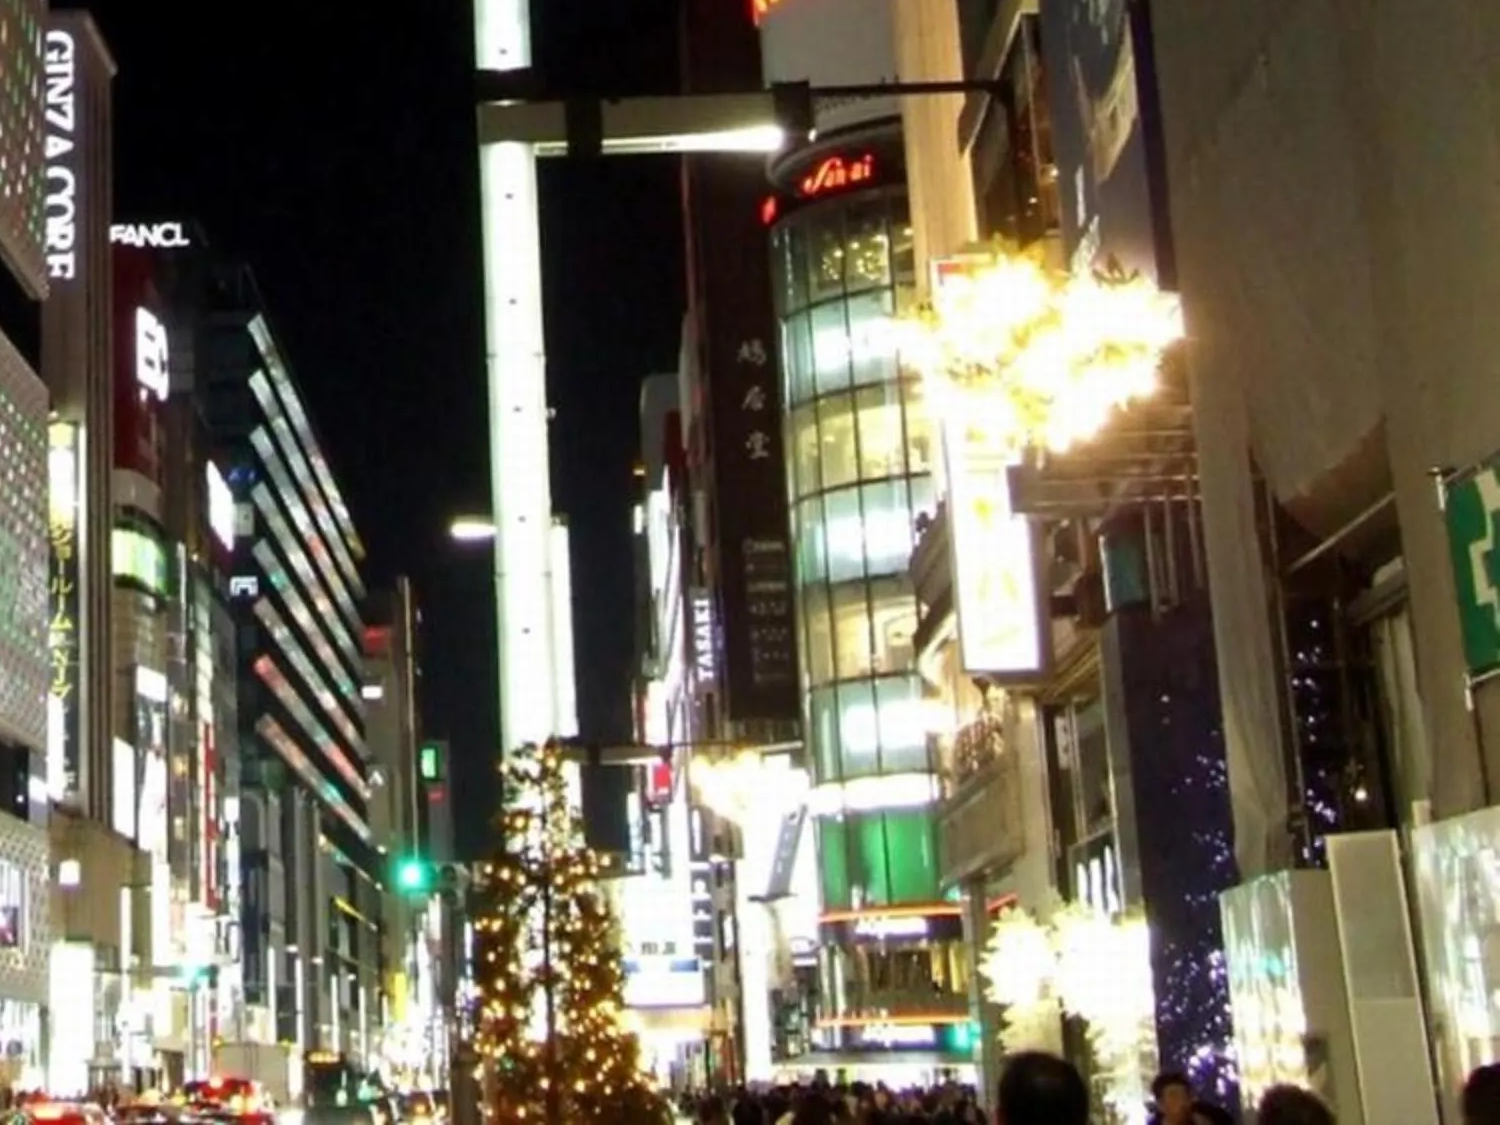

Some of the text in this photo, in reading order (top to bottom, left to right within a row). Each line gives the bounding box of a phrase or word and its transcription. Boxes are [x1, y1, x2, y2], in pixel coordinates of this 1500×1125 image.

[45, 29, 76, 159] GINZA
[108, 222, 191, 247] FANCL
[693, 598, 714, 682] TASAKI
